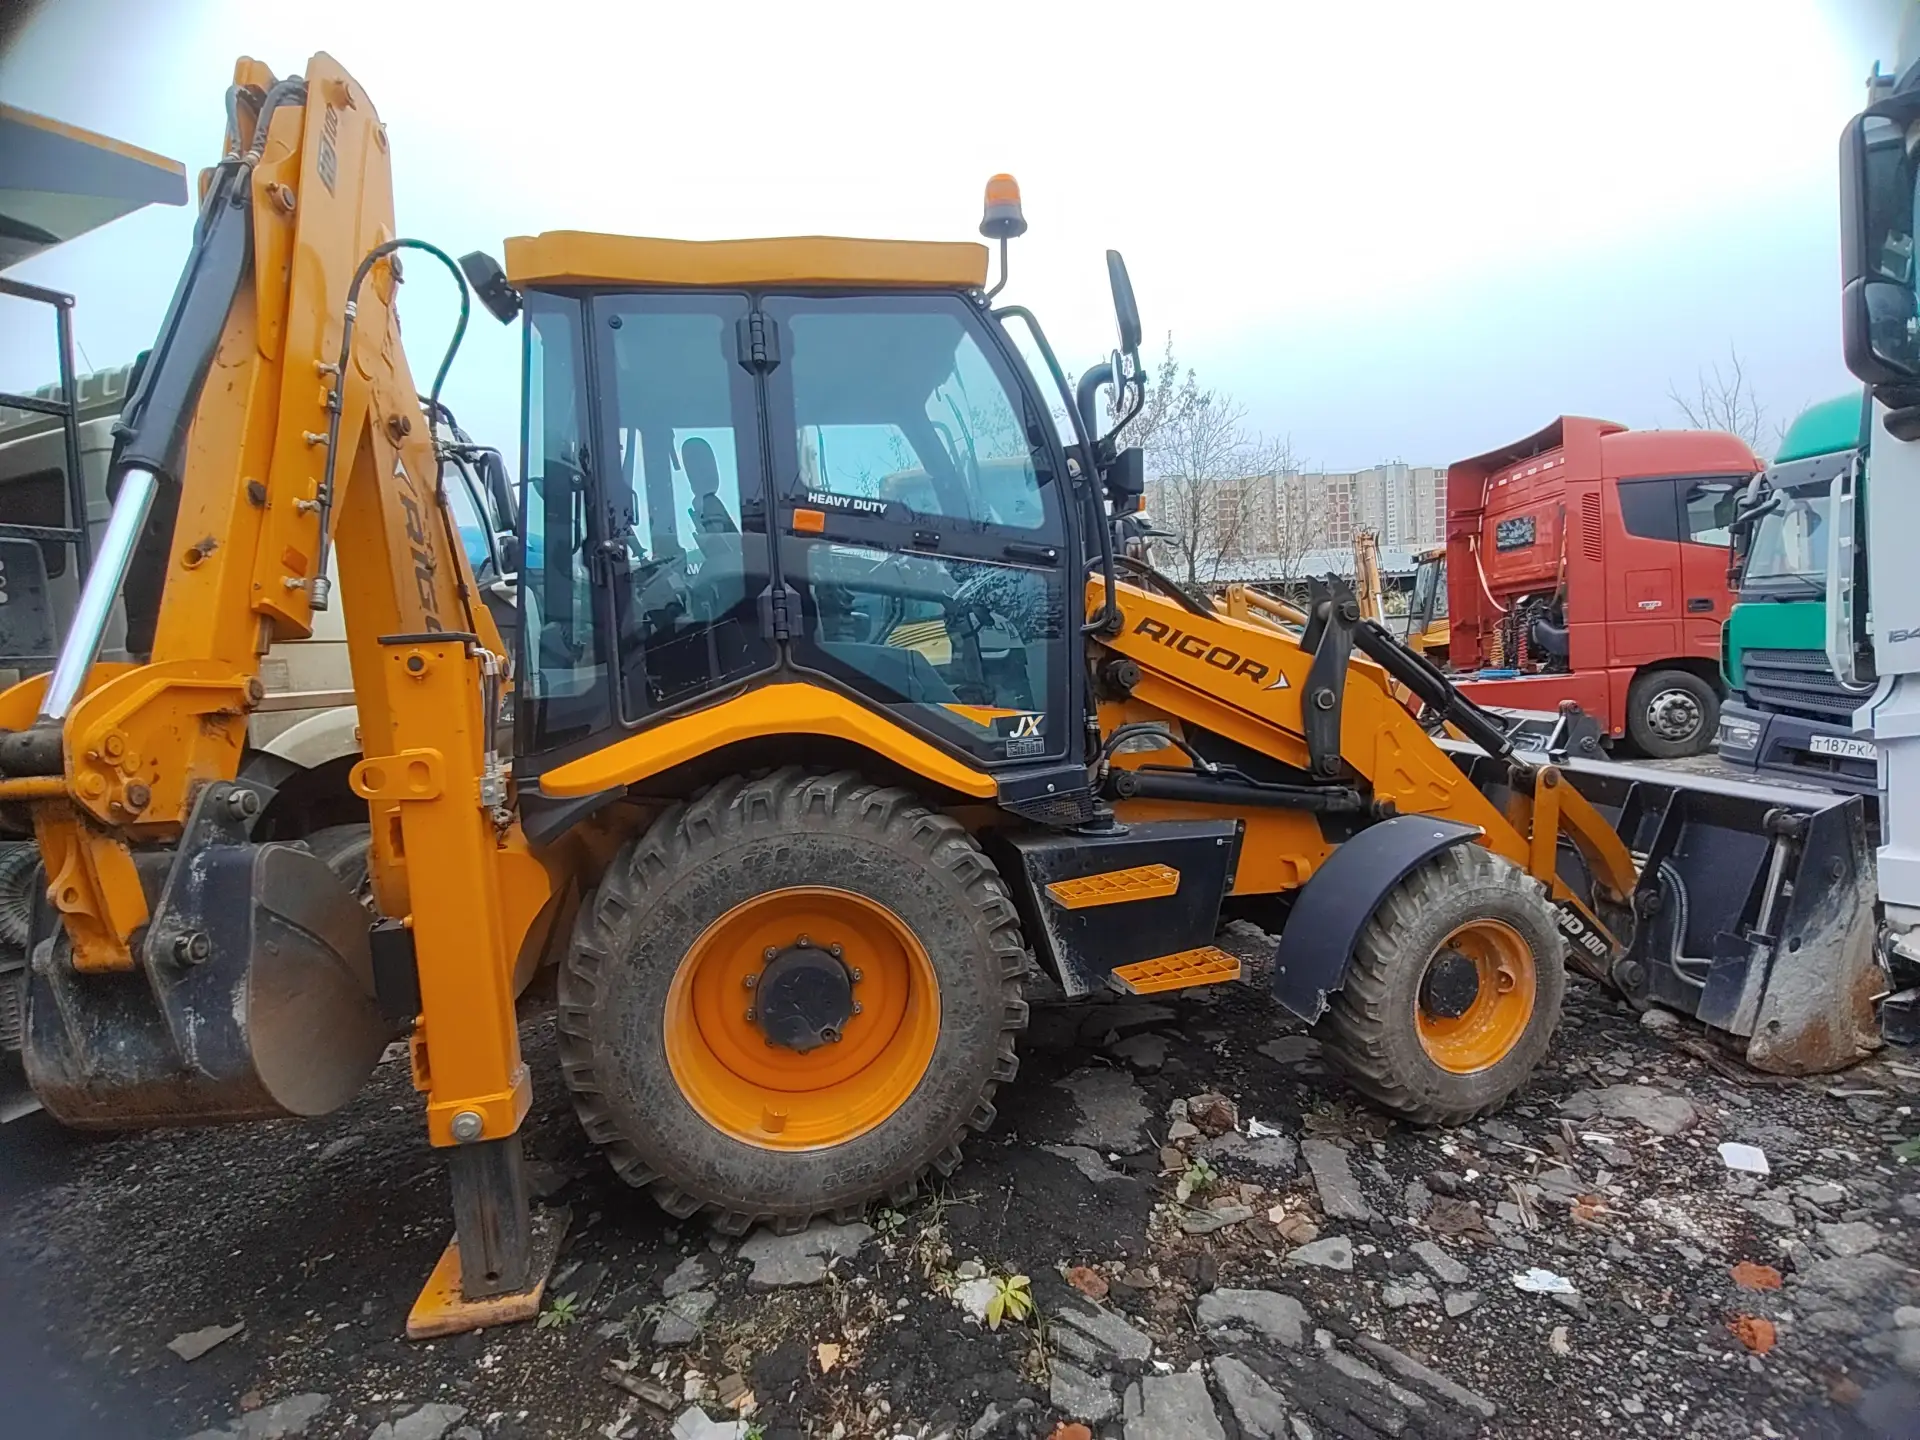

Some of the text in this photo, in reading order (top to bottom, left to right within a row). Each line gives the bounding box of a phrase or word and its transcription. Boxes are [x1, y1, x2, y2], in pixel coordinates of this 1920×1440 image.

[808, 492, 887, 513] HEAVY DUTY
[399, 491, 443, 632] RIG
[1132, 616, 1270, 685] RIGOR
[1009, 715, 1045, 737] JX
[1559, 907, 1608, 957] HD 100
